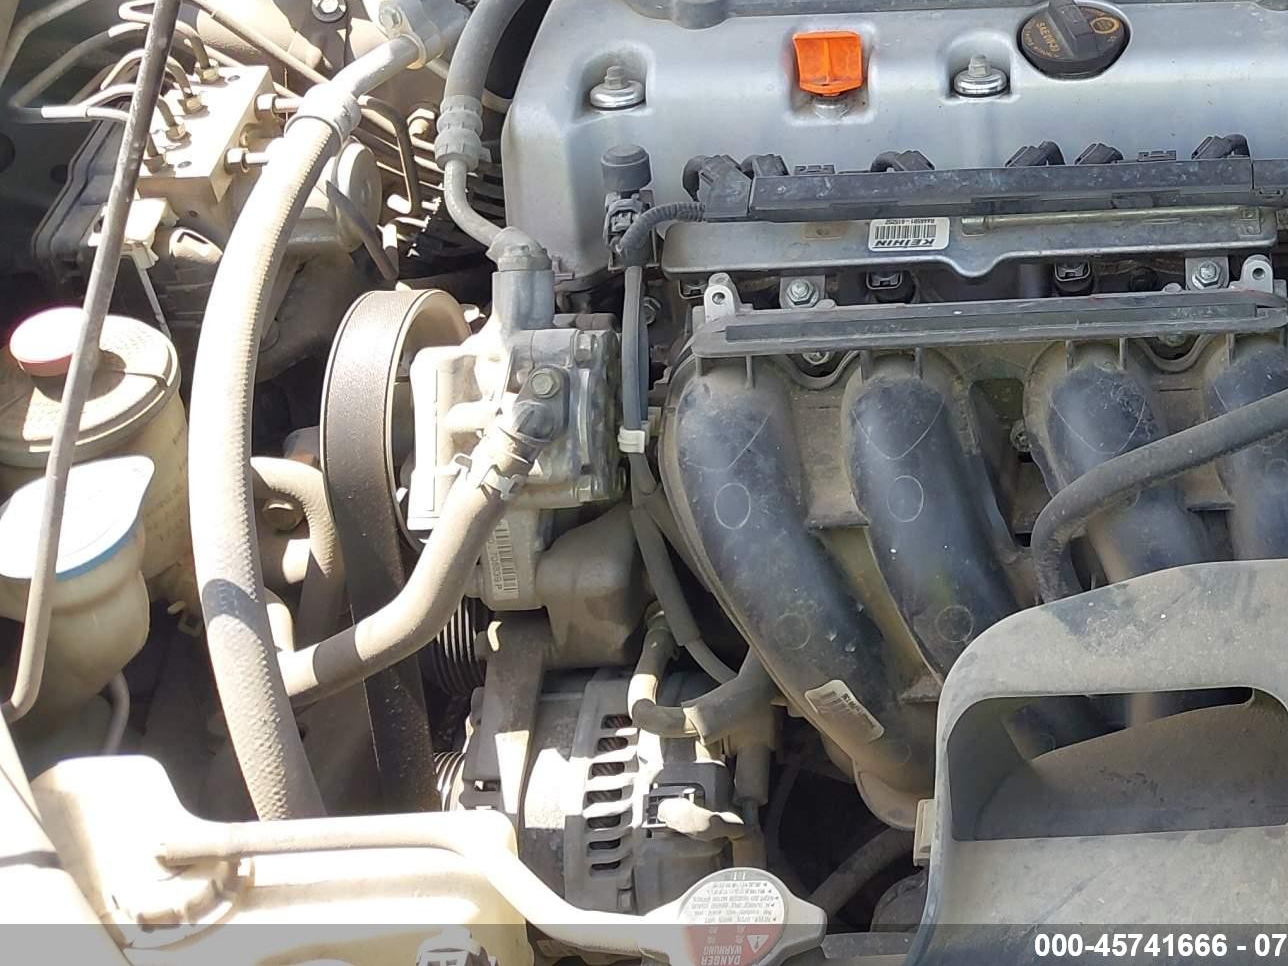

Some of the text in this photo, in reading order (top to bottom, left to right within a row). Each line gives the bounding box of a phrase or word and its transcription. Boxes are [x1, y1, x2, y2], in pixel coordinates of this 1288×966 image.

[875, 238, 935, 247] KEIHIN
[703, 945, 742, 955] WARNUNG
[701, 955, 741, 965] DANGER
